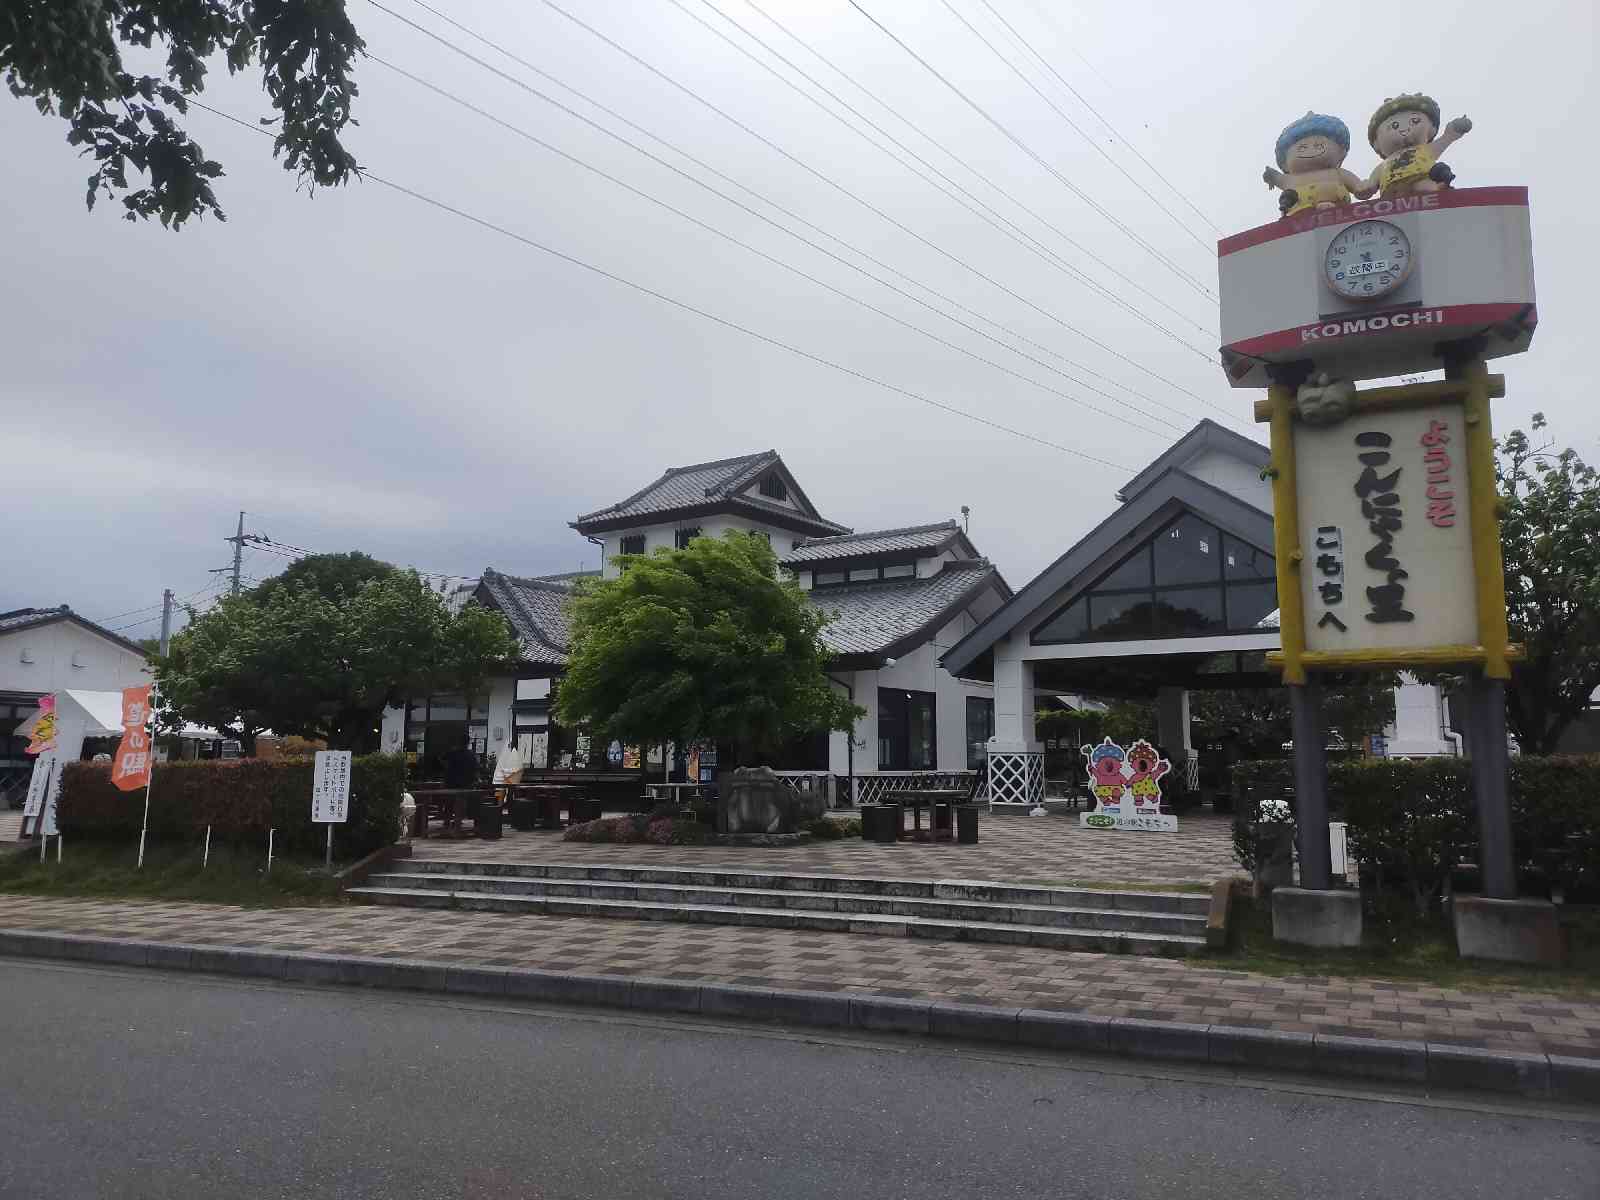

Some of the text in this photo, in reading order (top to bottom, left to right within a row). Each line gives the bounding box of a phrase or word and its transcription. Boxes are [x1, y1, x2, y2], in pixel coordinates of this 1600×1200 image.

[1360, 225, 1373, 236] 12
[1344, 231, 1355, 244] 11
[1389, 236, 1400, 246] 2
[1334, 246, 1346, 256] 10
[1394, 249, 1404, 259] 3
[1330, 259, 1341, 269] 9
[1335, 271, 1345, 281] 8
[1379, 275, 1391, 285] 5
[1347, 280, 1358, 289] 7
[1363, 282, 1374, 292] 6
[1301, 310, 1444, 341] KOMOCHI
[1421, 419, 1456, 527] ようこそ
[1316, 526, 1347, 632] こもちへ
